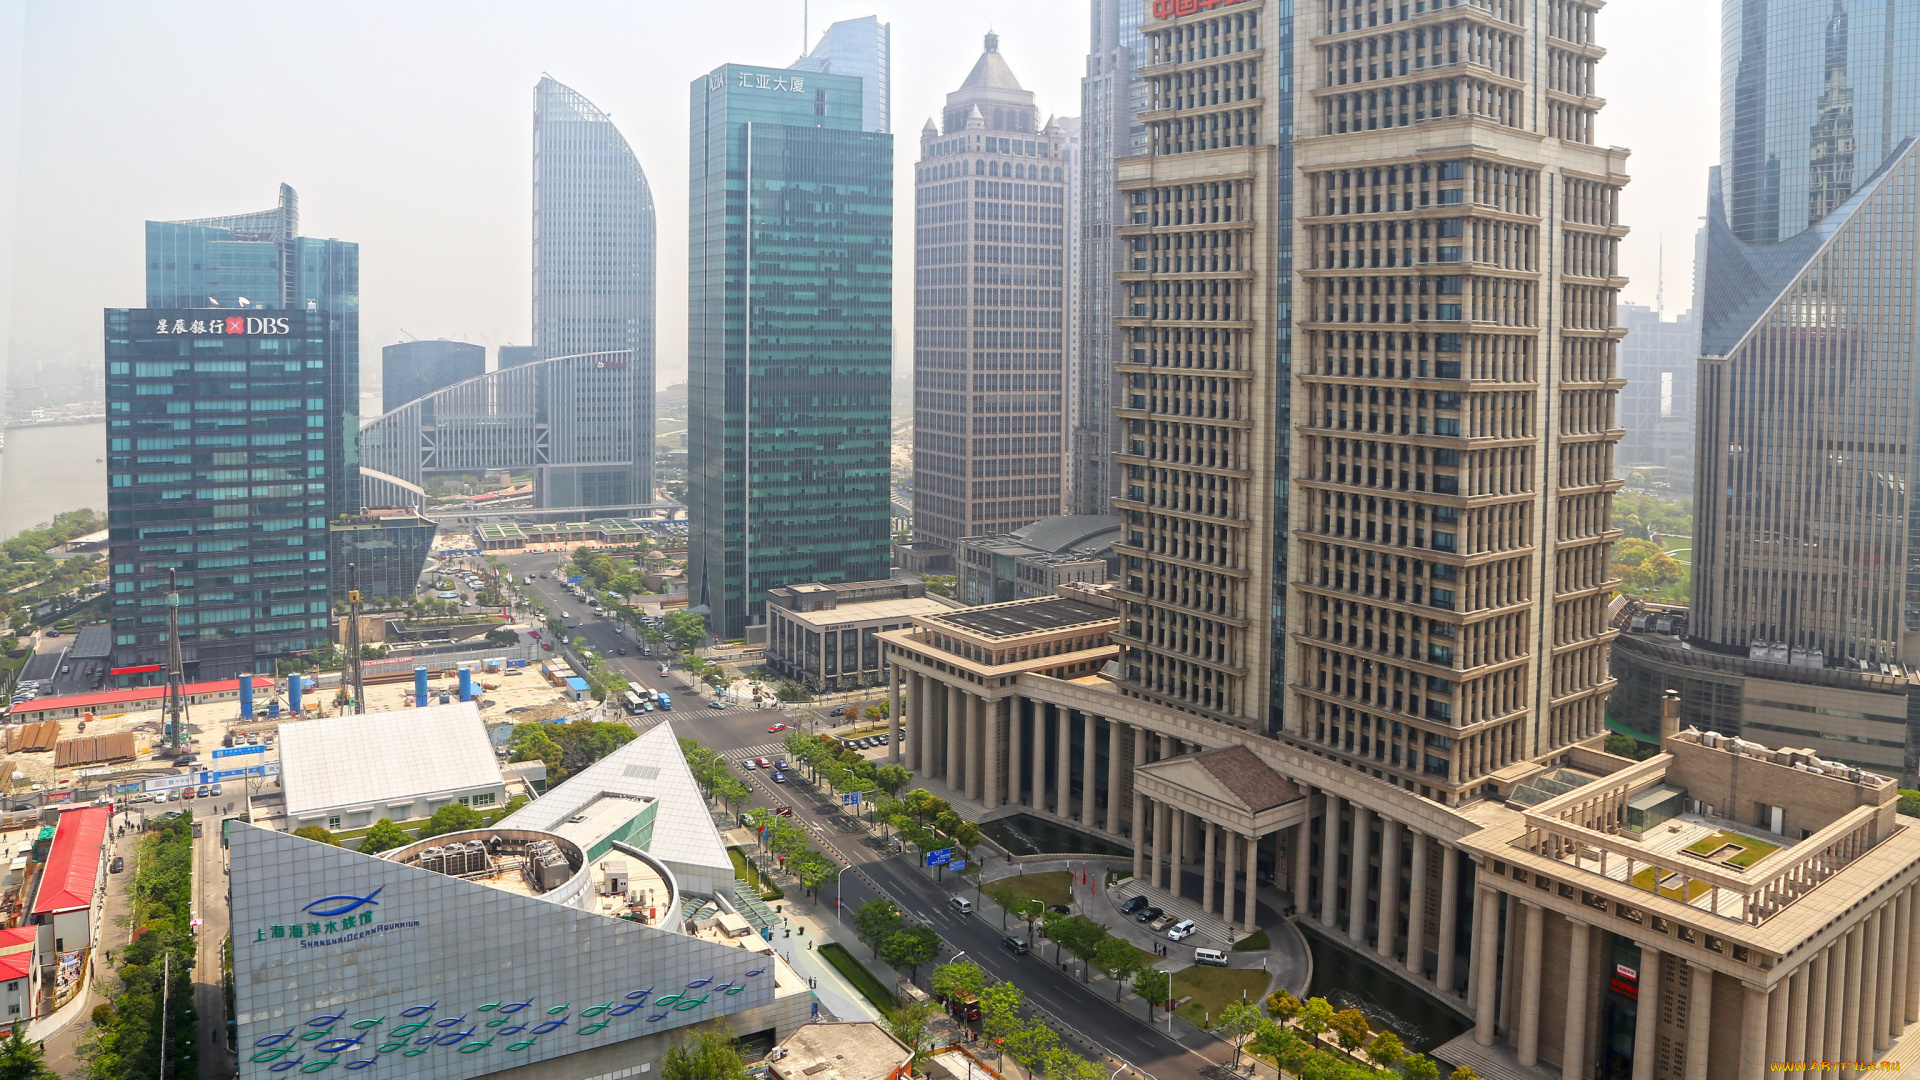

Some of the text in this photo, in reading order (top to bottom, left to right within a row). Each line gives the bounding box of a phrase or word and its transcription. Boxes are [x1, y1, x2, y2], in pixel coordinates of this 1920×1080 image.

[739, 72, 805, 93] 汇亚大厦
[246, 317, 290, 335] DBS
[253, 910, 373, 943] 上海海洋水族馆
